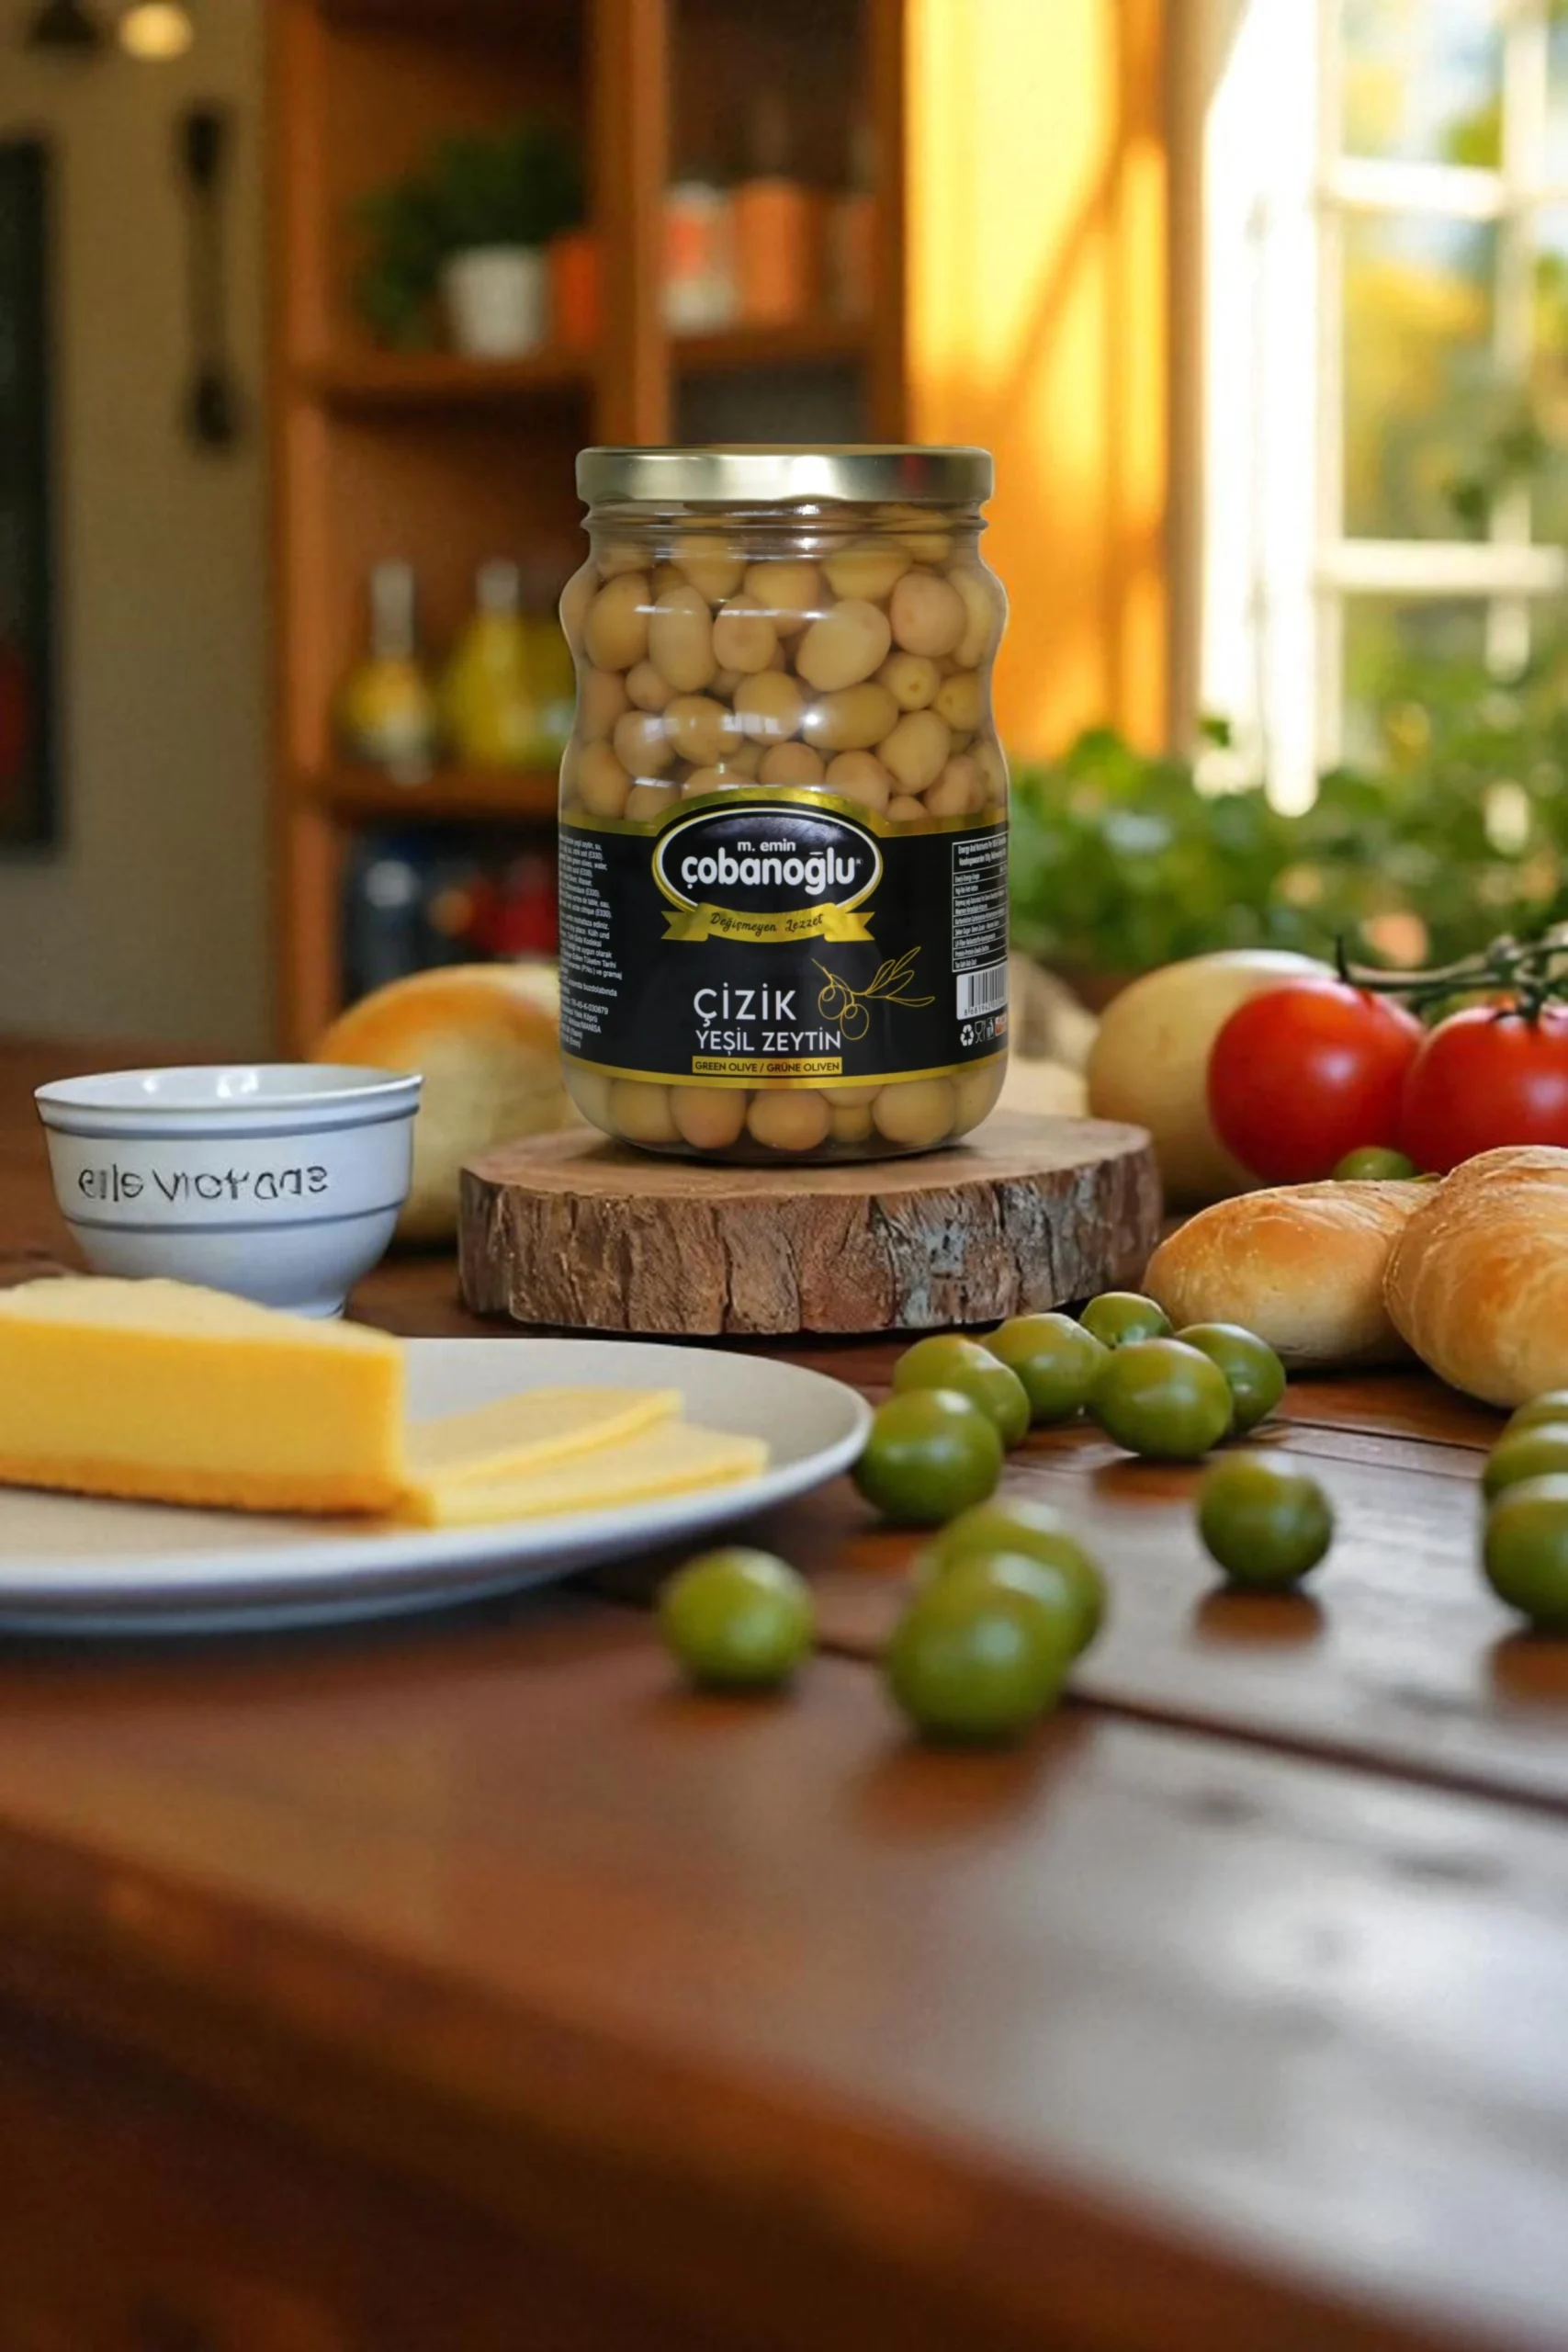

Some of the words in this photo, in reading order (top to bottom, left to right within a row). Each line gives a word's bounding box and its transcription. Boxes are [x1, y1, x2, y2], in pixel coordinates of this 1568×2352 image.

[738, 841, 755, 852] m.
[760, 838, 795, 852] emin
[681, 846, 855, 896] çobanoğlu
[784, 913, 824, 933] Lezzet
[604, 970, 623, 980] gramaj
[694, 982, 797, 1027] ÇİZİK
[695, 1027, 755, 1057] YEŞİL
[761, 1027, 841, 1051] ZEYTİN
[694, 1061, 727, 1071] GREEN
[728, 1062, 758, 1072] OLIVE
[766, 1061, 801, 1073] GRÜNE
[803, 1062, 840, 1071] OLIVEN
